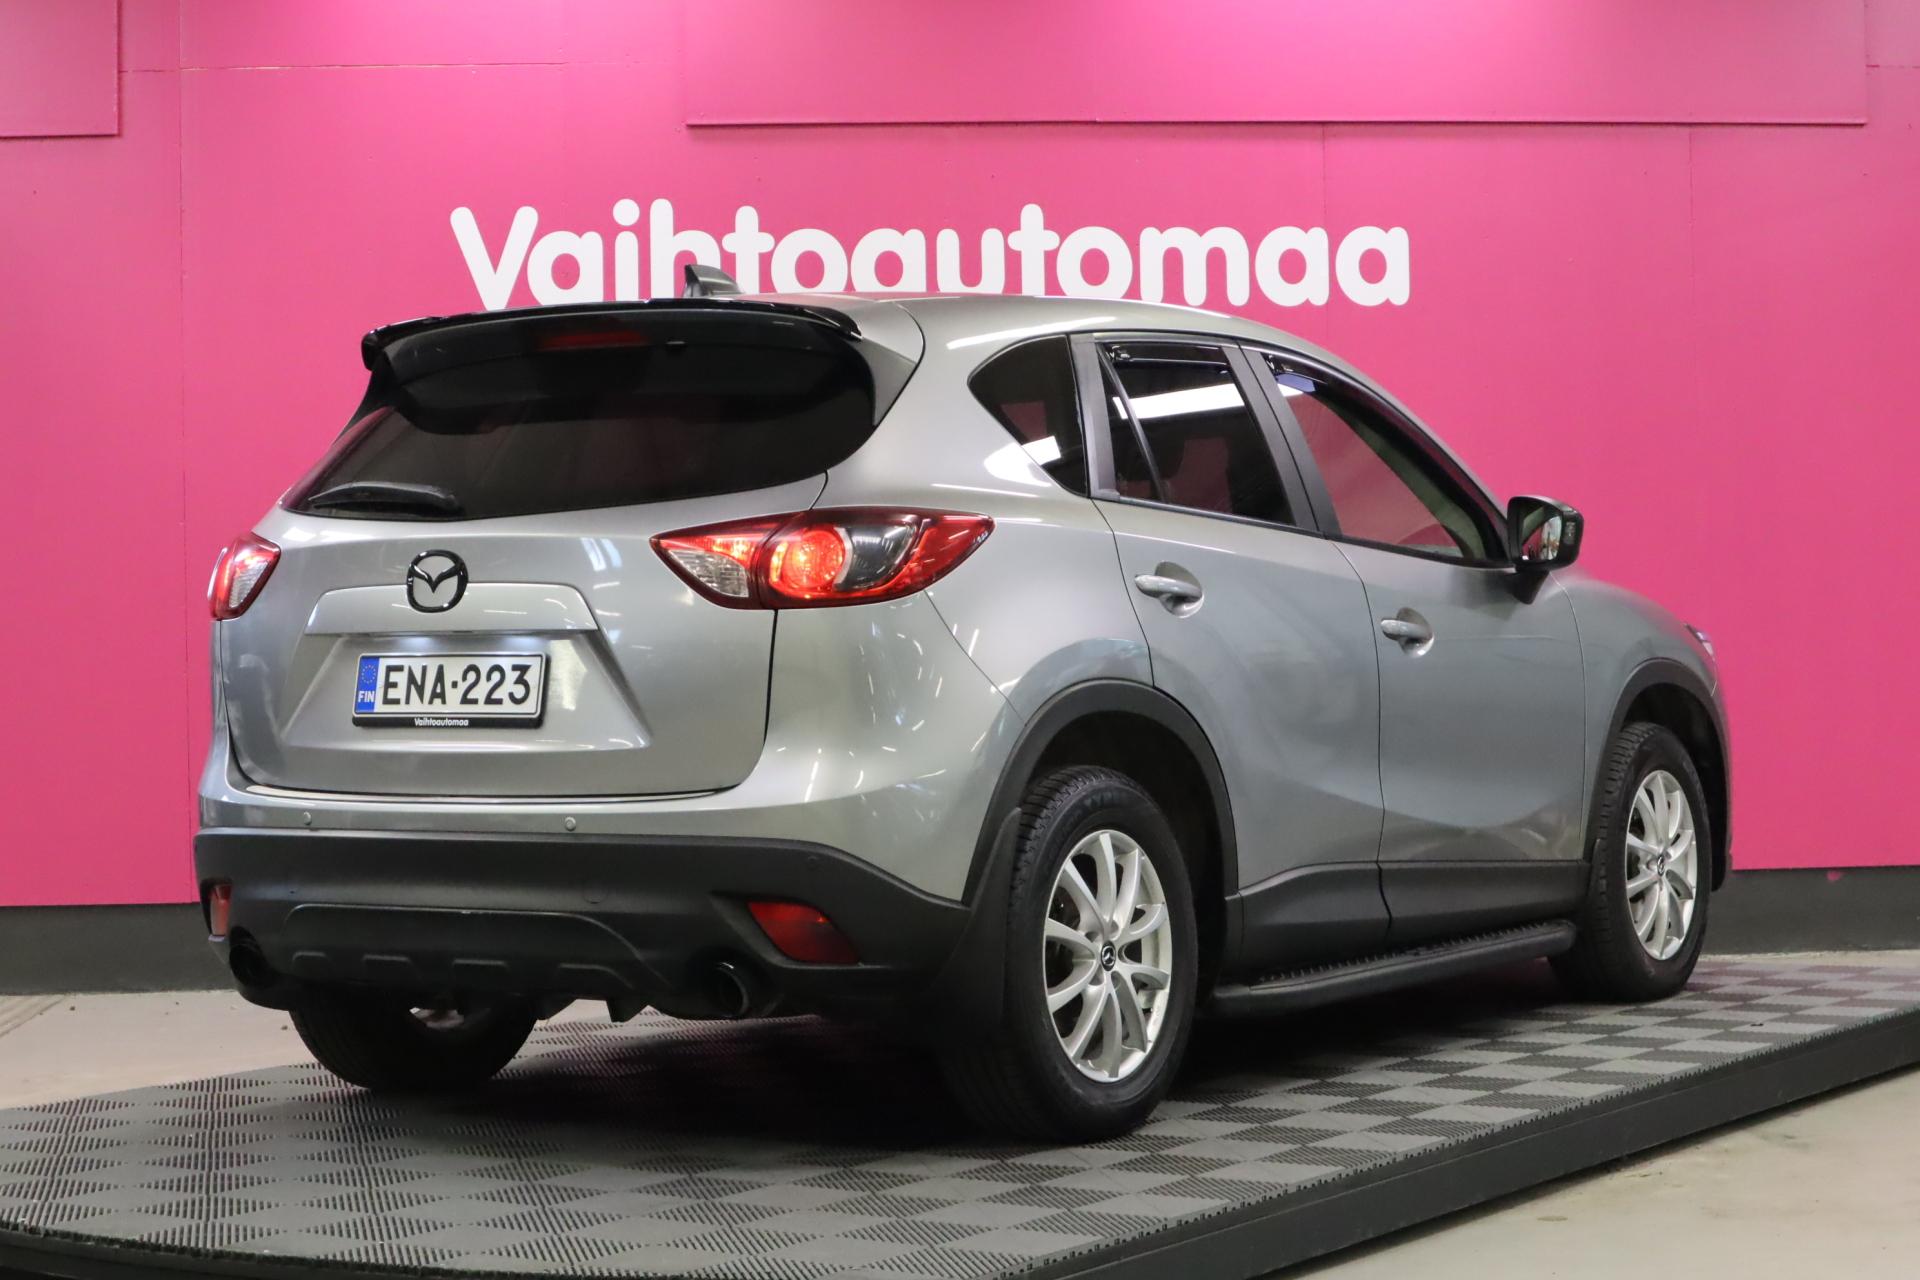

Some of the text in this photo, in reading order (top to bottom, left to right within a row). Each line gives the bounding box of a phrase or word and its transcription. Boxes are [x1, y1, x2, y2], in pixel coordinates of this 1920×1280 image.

[450, 198, 1410, 311] Vaihtoautomaa
[358, 690, 375, 702] FIN
[414, 717, 469, 727] Vaihtoautomaa
